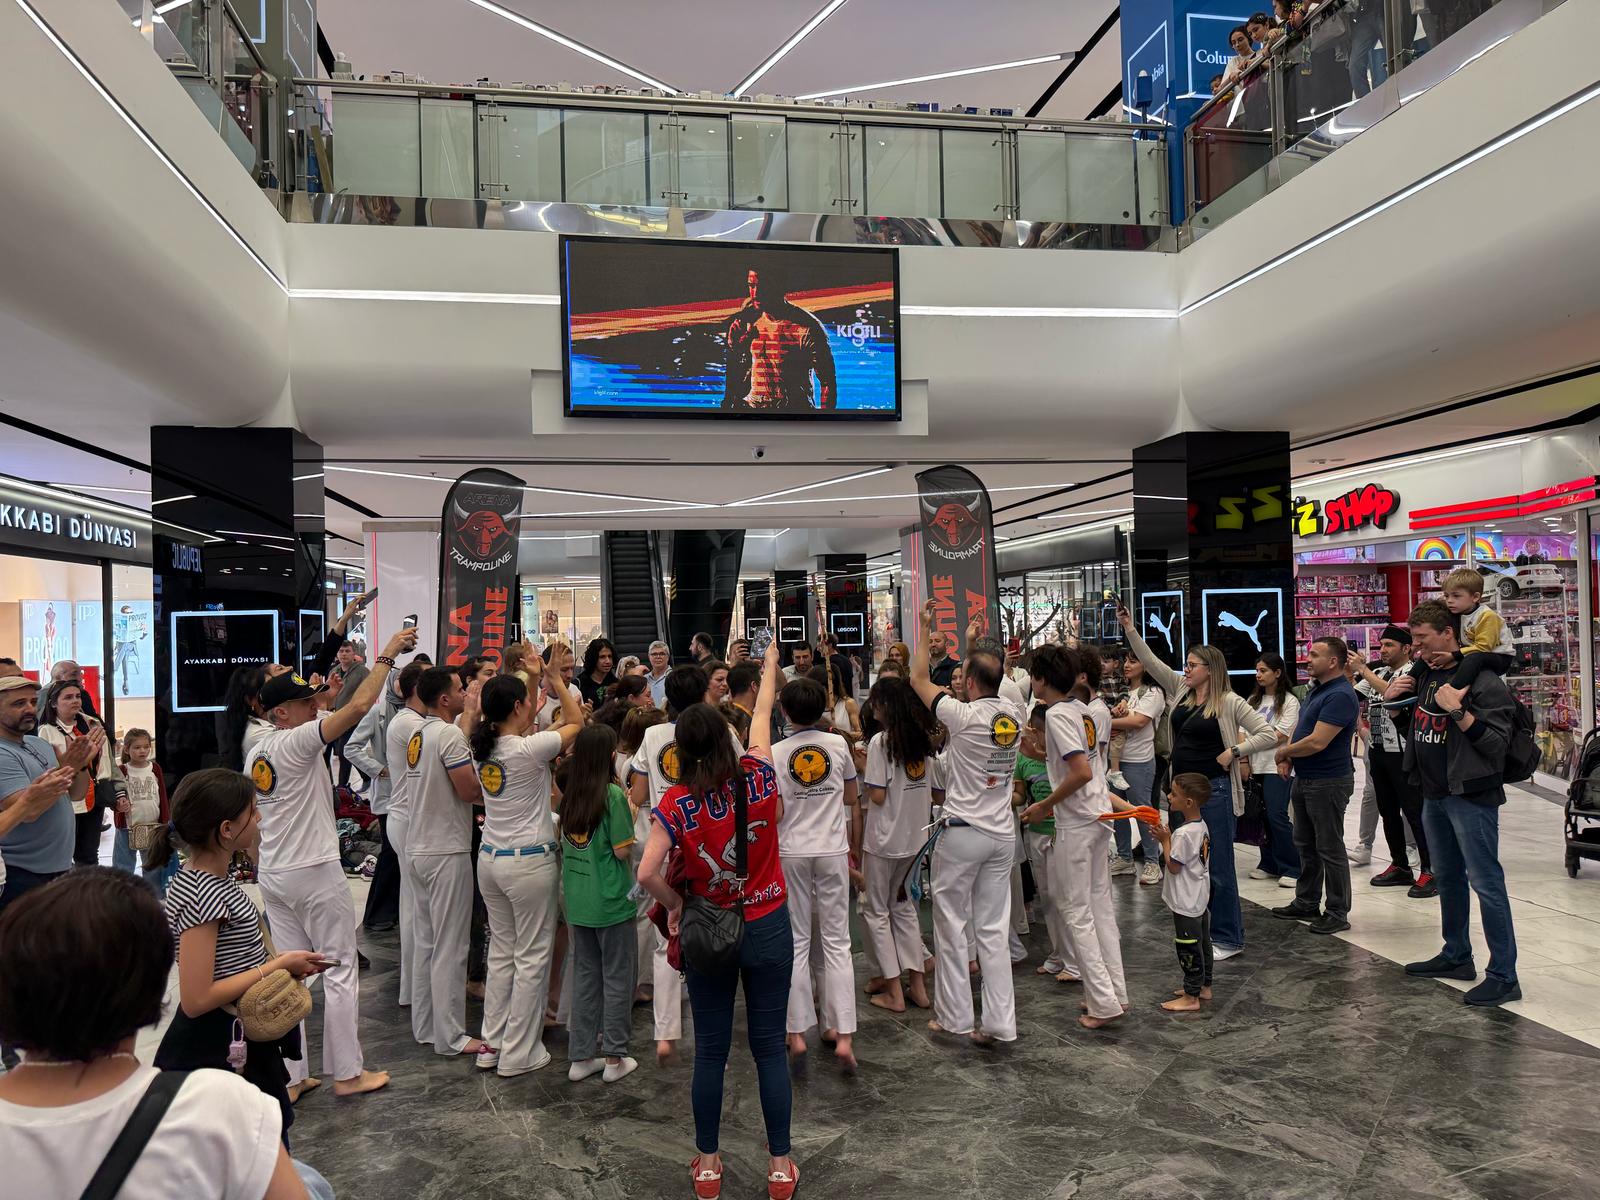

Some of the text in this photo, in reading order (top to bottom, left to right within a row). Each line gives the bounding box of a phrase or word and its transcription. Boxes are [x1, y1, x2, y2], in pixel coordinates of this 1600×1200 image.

[1324, 482, 1396, 536] SHOP
[69, 513, 137, 549] DÜNYASI
[449, 546, 513, 572] TRAMPOLINE
[183, 656, 269, 666] AYAKKABI DÜNYASI
